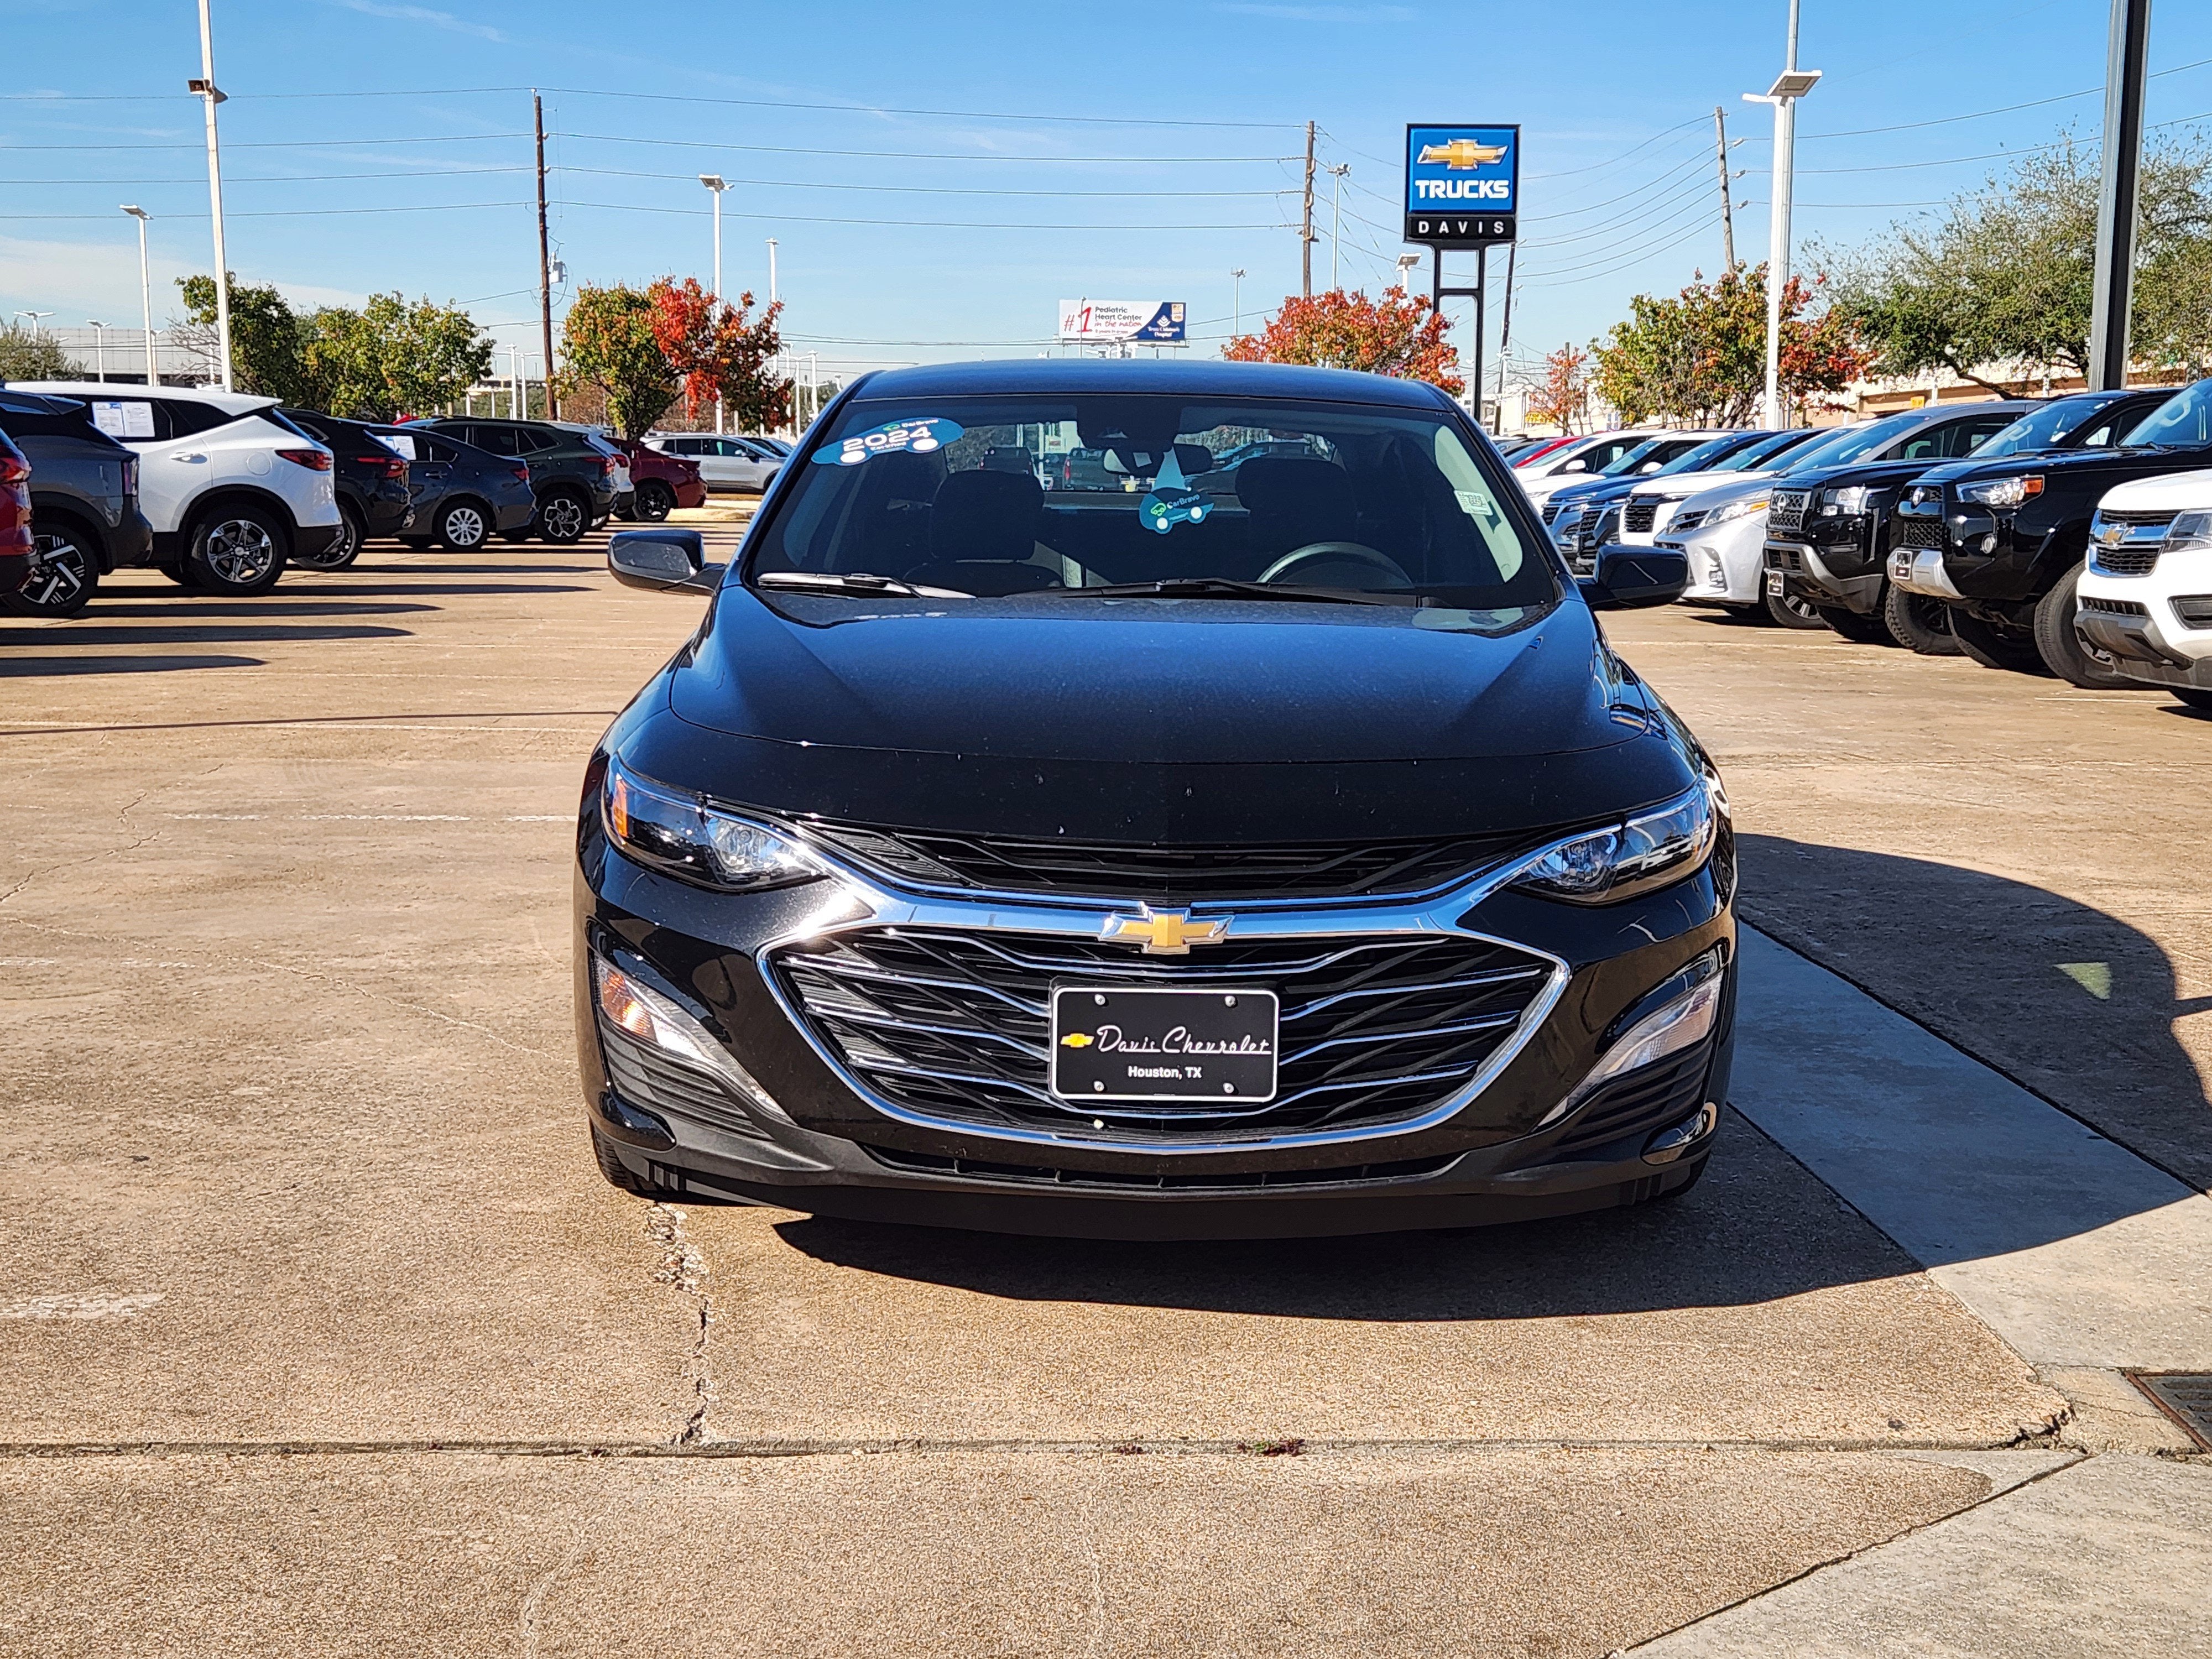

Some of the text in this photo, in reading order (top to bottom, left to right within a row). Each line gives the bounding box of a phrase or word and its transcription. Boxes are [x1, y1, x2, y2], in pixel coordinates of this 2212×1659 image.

[1415, 180, 1509, 199] TRUCKS
[1418, 221, 1504, 234] DAVIS
[1064, 306, 1093, 332] #1
[843, 426, 931, 452] 2024
[1166, 494, 1200, 509] CarBravo
[1097, 1025, 1272, 1055] Davis Chevrolet
[1128, 1066, 1202, 1080] Houston, TX
